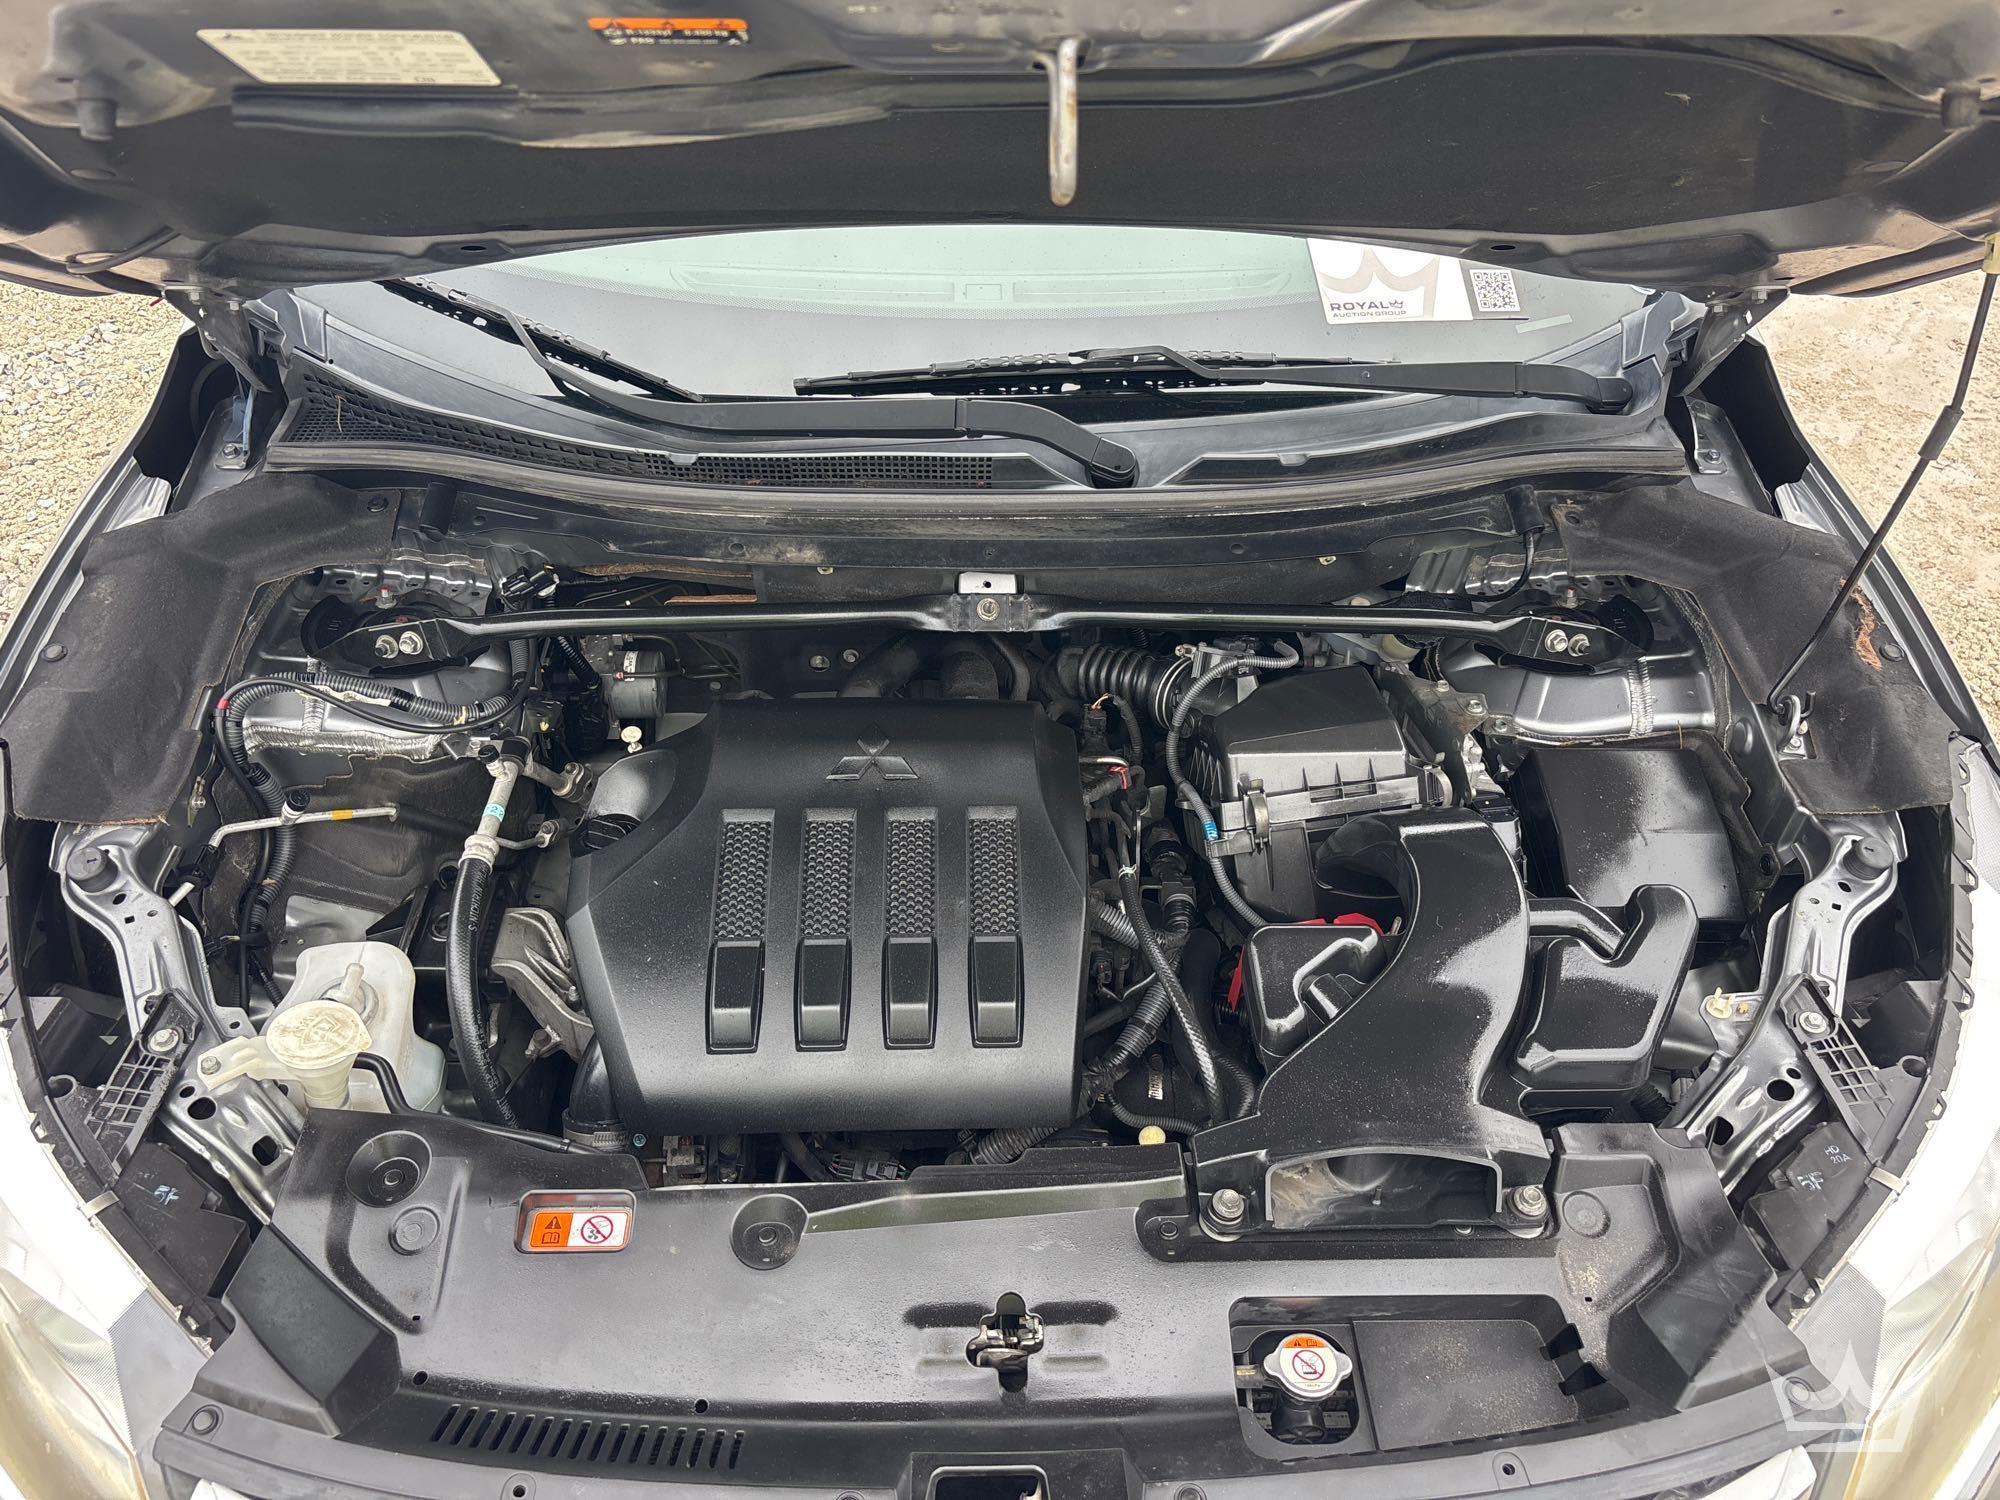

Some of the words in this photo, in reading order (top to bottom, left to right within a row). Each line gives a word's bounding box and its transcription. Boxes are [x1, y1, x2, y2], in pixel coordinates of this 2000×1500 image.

[1330, 301, 1389, 311] ROYAL
[1824, 1145, 1839, 1155] HD
[1830, 1153, 1852, 1164] 20A
